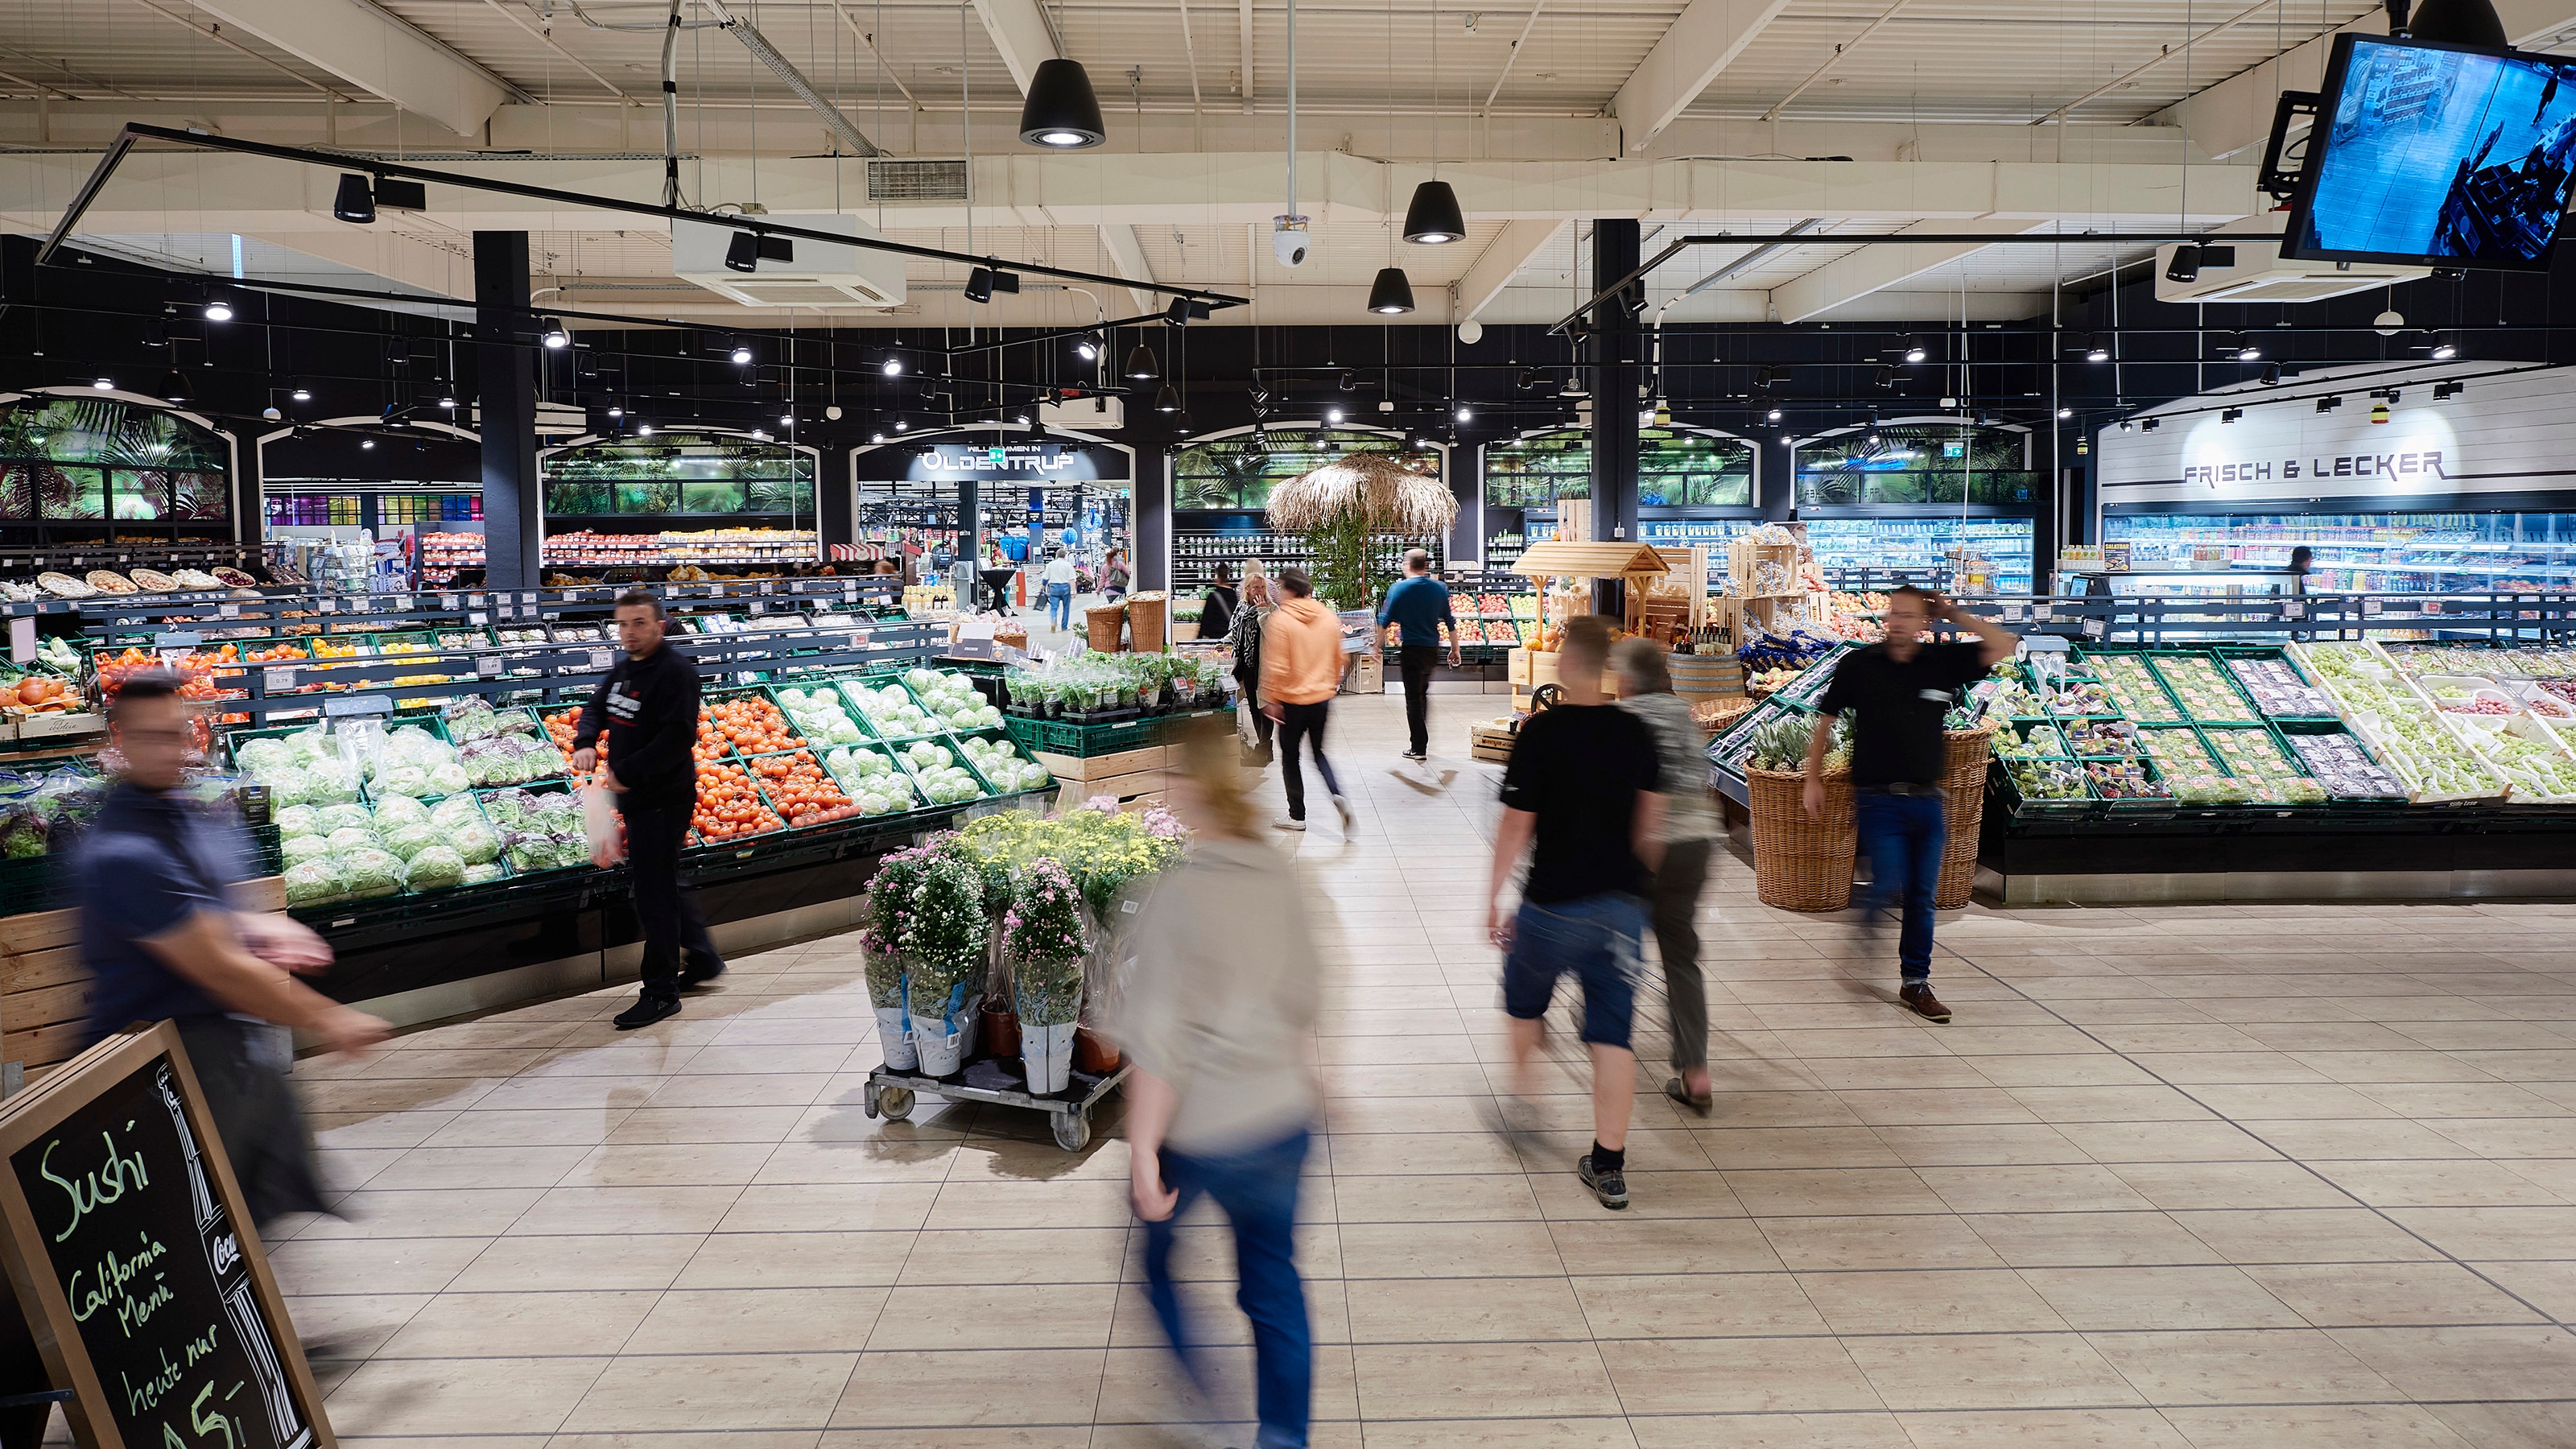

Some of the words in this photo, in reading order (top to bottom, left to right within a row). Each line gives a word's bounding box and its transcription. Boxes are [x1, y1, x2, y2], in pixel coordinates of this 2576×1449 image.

[922, 450, 1075, 476] OLDENTRUP
[2184, 460, 2271, 489] FRISCH
[2283, 460, 2301, 478] &
[2314, 451, 2447, 482] LECKER
[40, 1120, 150, 1243] Sushi
[69, 1231, 167, 1322] California
[213, 1232, 242, 1276] Coca
[117, 1272, 174, 1338] Menü
[121, 1348, 183, 1417] heute
[186, 1324, 218, 1368] nur
